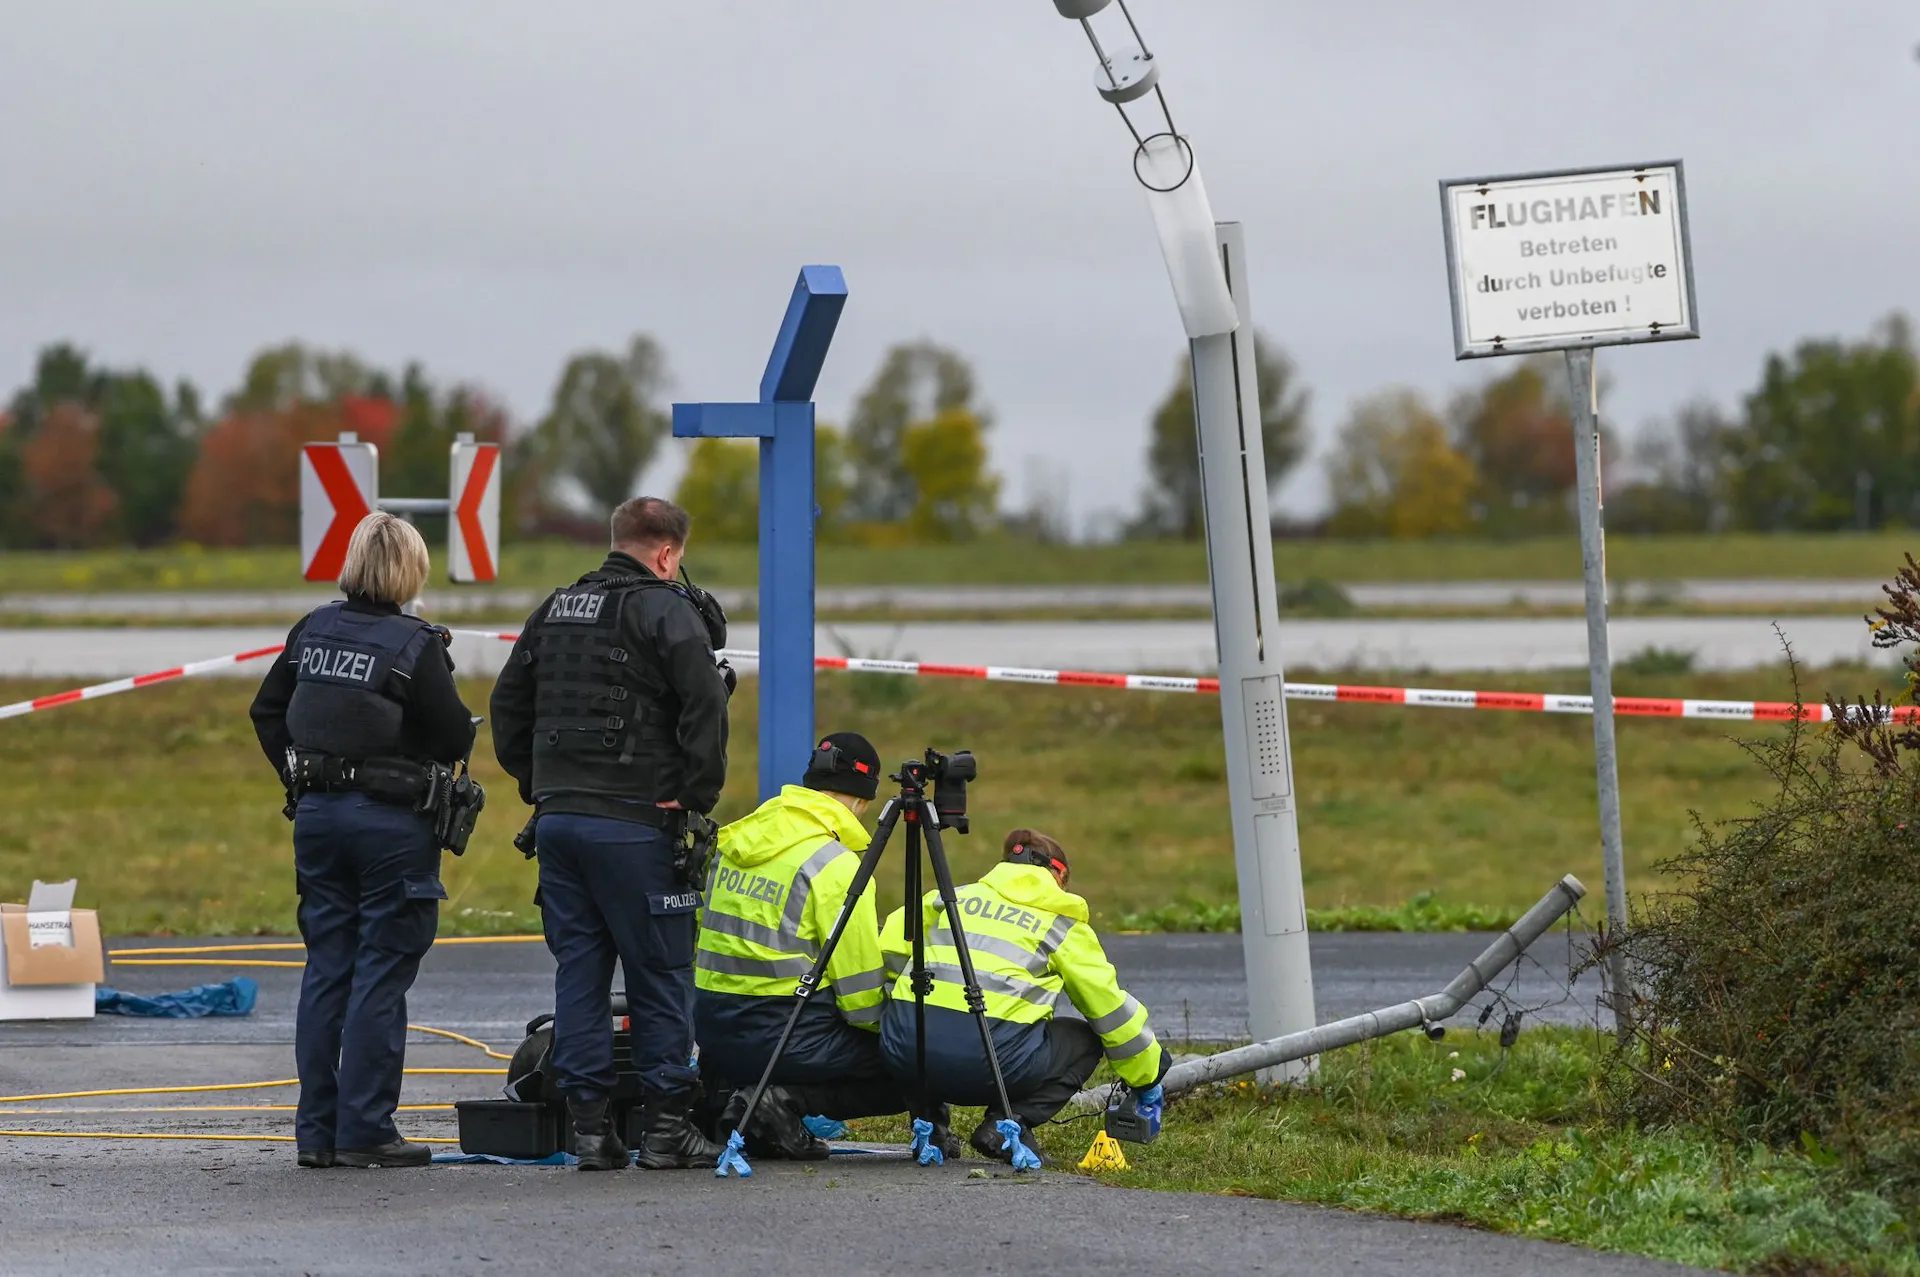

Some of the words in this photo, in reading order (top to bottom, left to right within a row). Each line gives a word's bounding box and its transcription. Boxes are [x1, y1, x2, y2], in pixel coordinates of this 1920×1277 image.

[1470, 190, 1661, 230] FLUGHAFEN
[1520, 235, 1618, 258] Betreten
[1477, 273, 1541, 293] durch
[1550, 263, 1667, 287] Unbefugte
[1517, 299, 1617, 321] verboten
[548, 593, 604, 618] POLIZEI
[300, 647, 376, 682] POLIZEI
[717, 866, 785, 906] POLIZEI
[664, 893, 696, 909] POLIZEI
[1093, 1142, 1103, 1157] 17
